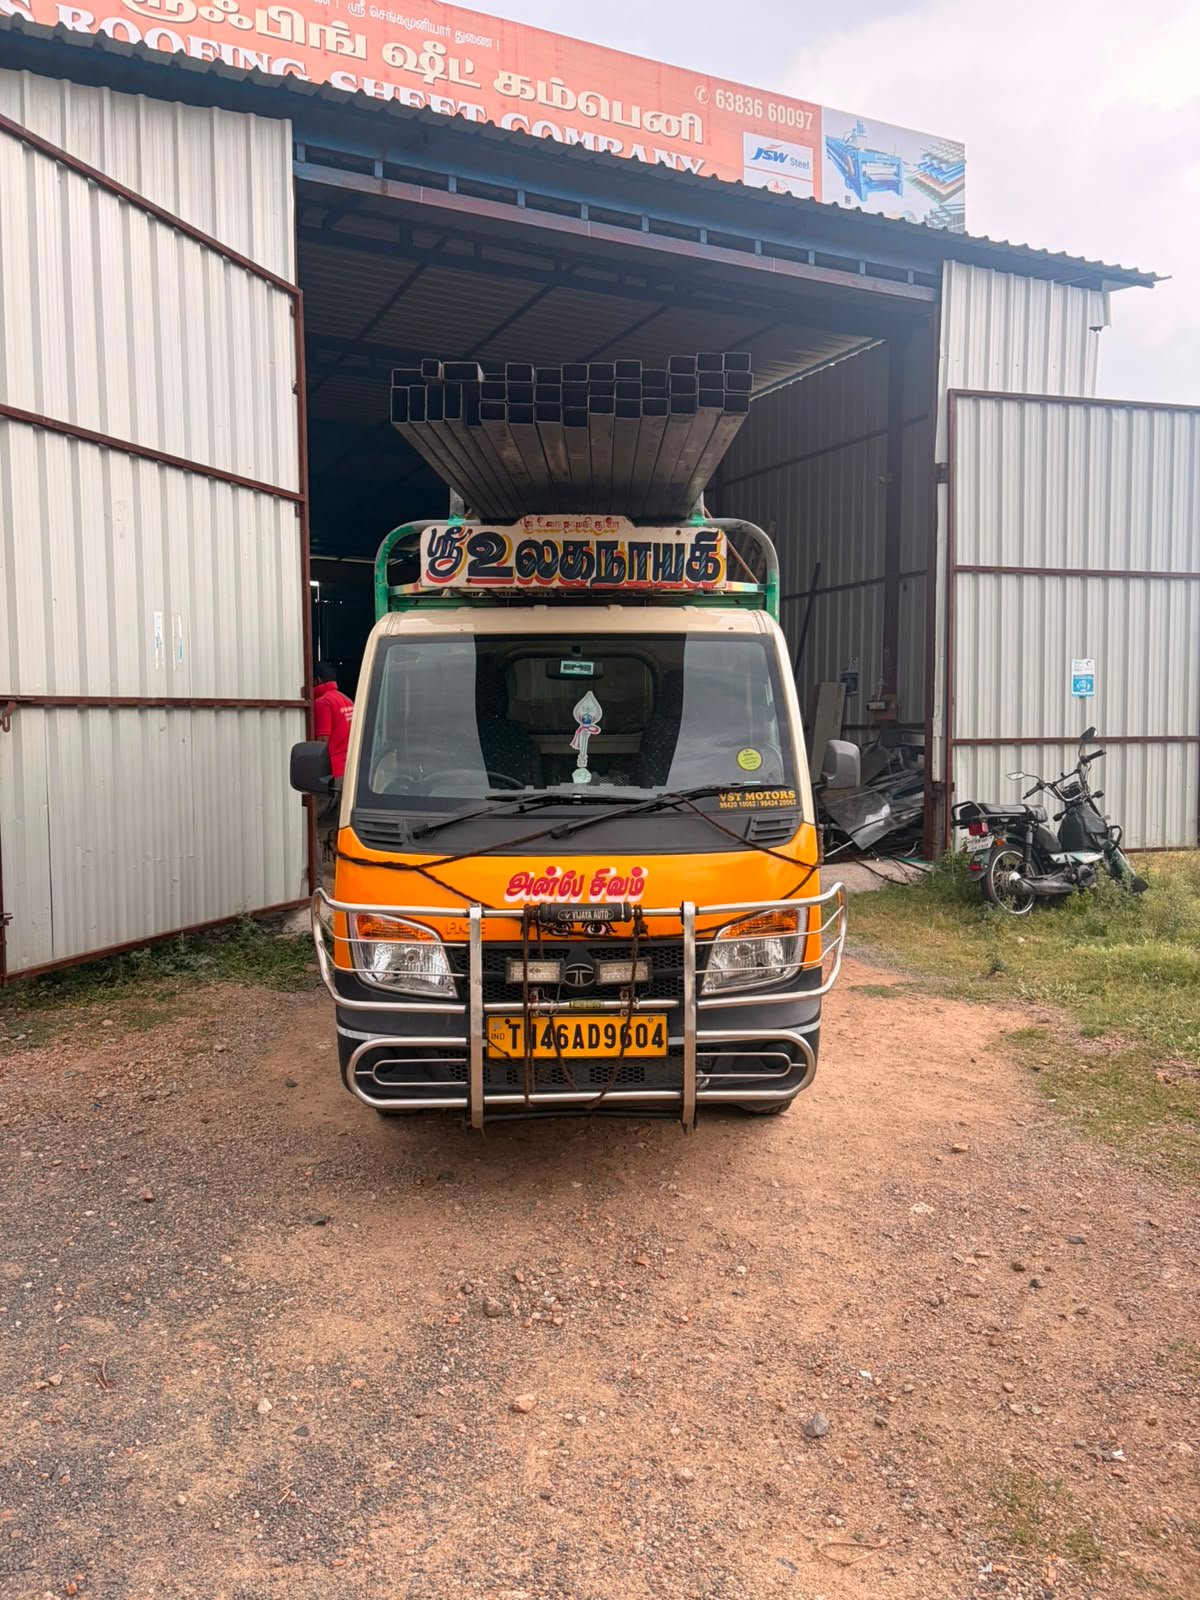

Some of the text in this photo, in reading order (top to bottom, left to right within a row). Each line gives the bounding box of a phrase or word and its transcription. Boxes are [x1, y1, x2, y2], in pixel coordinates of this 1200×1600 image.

[330, 71, 488, 122] SHEET
[382, 40, 481, 89] ஷீட்
[493, 69, 704, 144] கம்பெனி
[715, 89, 813, 130] 63836 60097
[750, 147, 810, 170] JSW Steel
[466, 530, 724, 586] உலகநாயகி
[719, 790, 796, 802] VST MOTORS
[505, 865, 649, 901] அன்பே சிவம்
[572, 910, 593, 920] VIJAYA
[593, 910, 609, 920] AUTO
